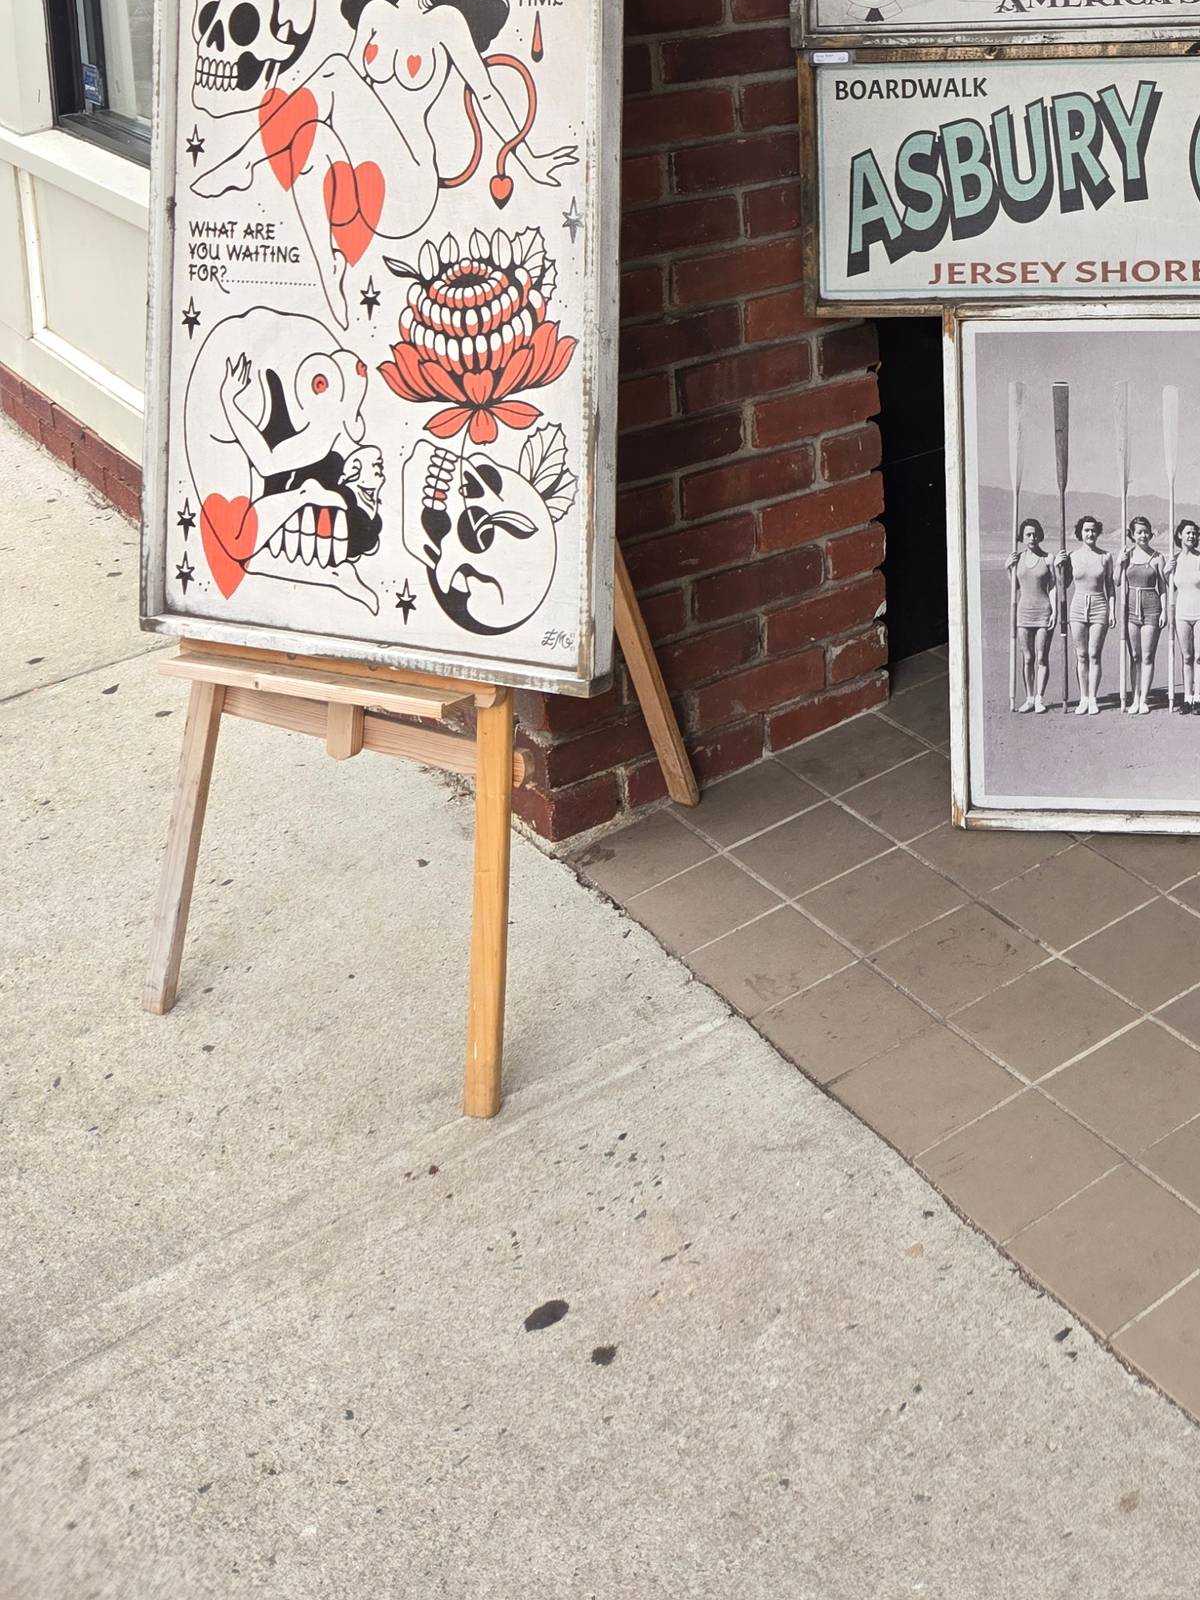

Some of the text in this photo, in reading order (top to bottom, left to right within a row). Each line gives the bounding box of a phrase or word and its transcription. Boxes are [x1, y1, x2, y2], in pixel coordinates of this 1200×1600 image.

[835, 77, 988, 101] BOARDWALK
[846, 79, 1163, 278] ASBURY
[189, 220, 275, 240] WHAT ARE
[189, 242, 300, 263] YOU WAITING
[928, 260, 1066, 286] JERSEY
